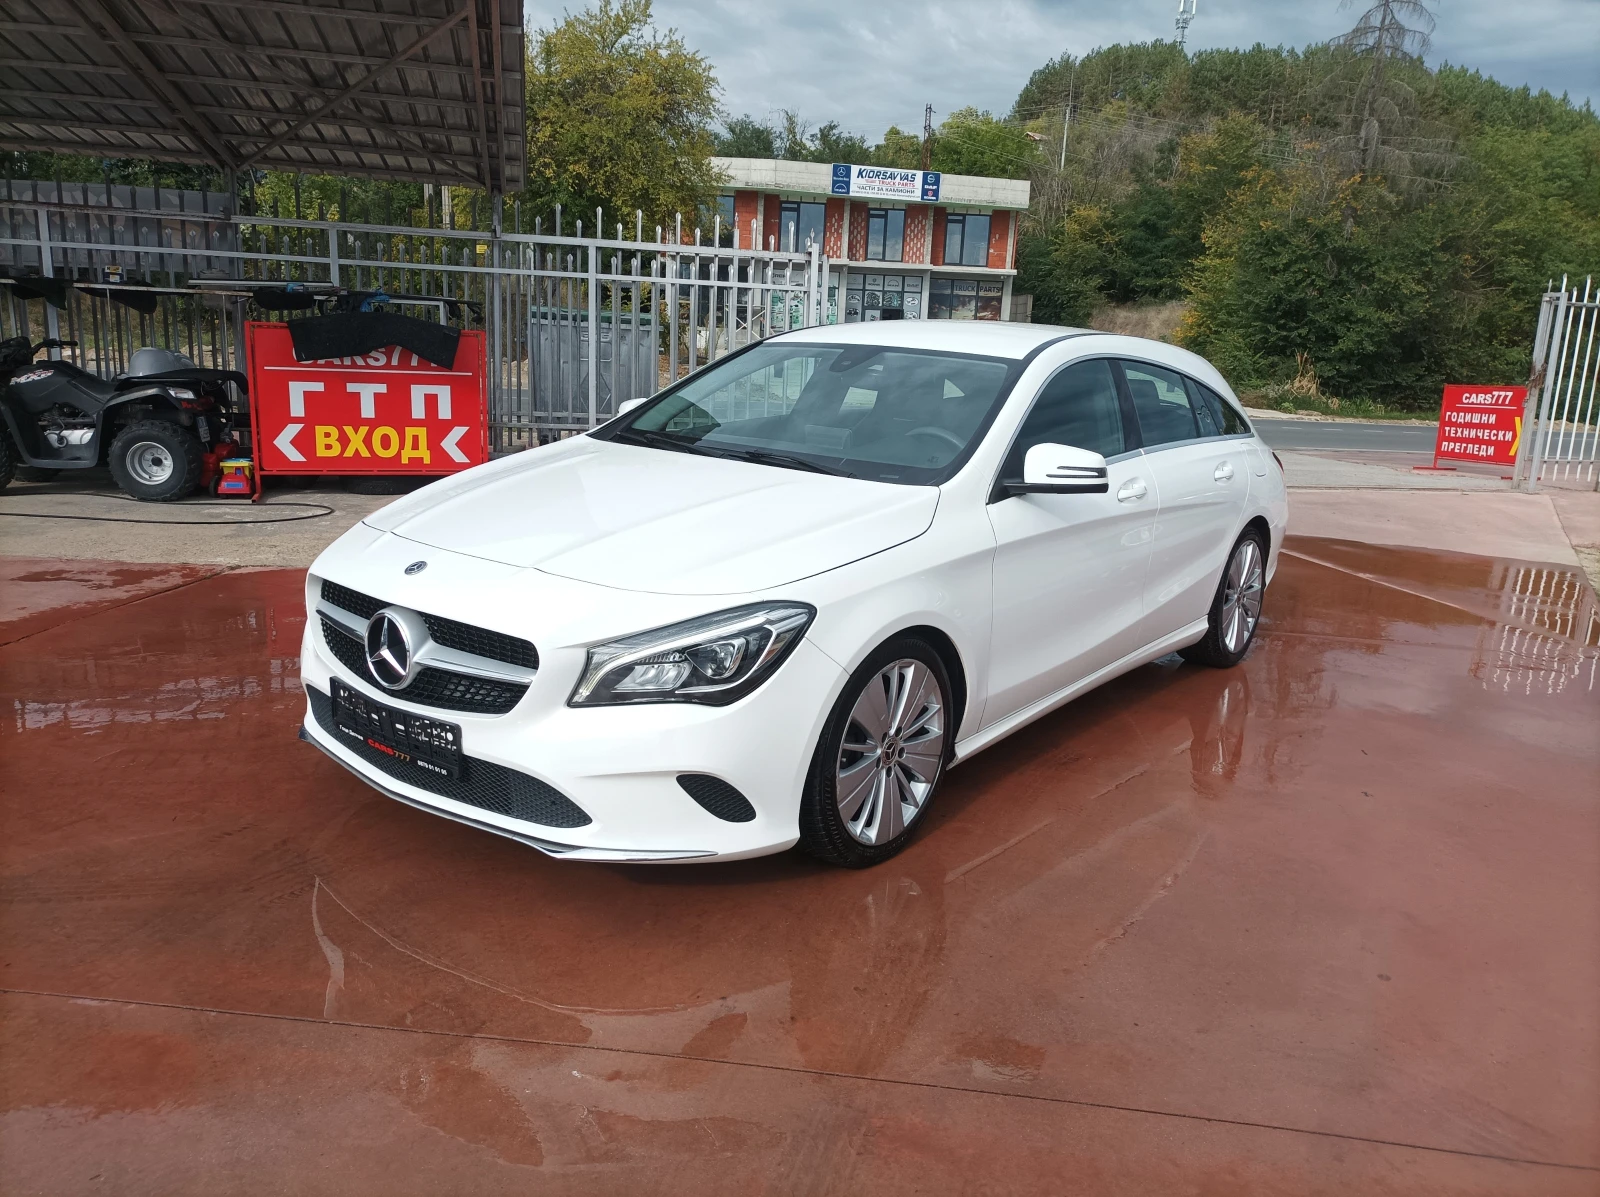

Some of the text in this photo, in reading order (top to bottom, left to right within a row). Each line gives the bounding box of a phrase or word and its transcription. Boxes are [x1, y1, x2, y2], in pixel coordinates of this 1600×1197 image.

[954, 284, 976, 292] TRUCK
[1462, 391, 1513, 404] CARS777
[1445, 411, 1496, 424] ГОДИШНИ
[1444, 426, 1513, 441] ТЕХНИЧЕСКИ
[314, 425, 431, 465] ВХОД
[1441, 441, 1495, 457] ПРЕГЛЕДИ
[367, 738, 411, 762] CARS777
